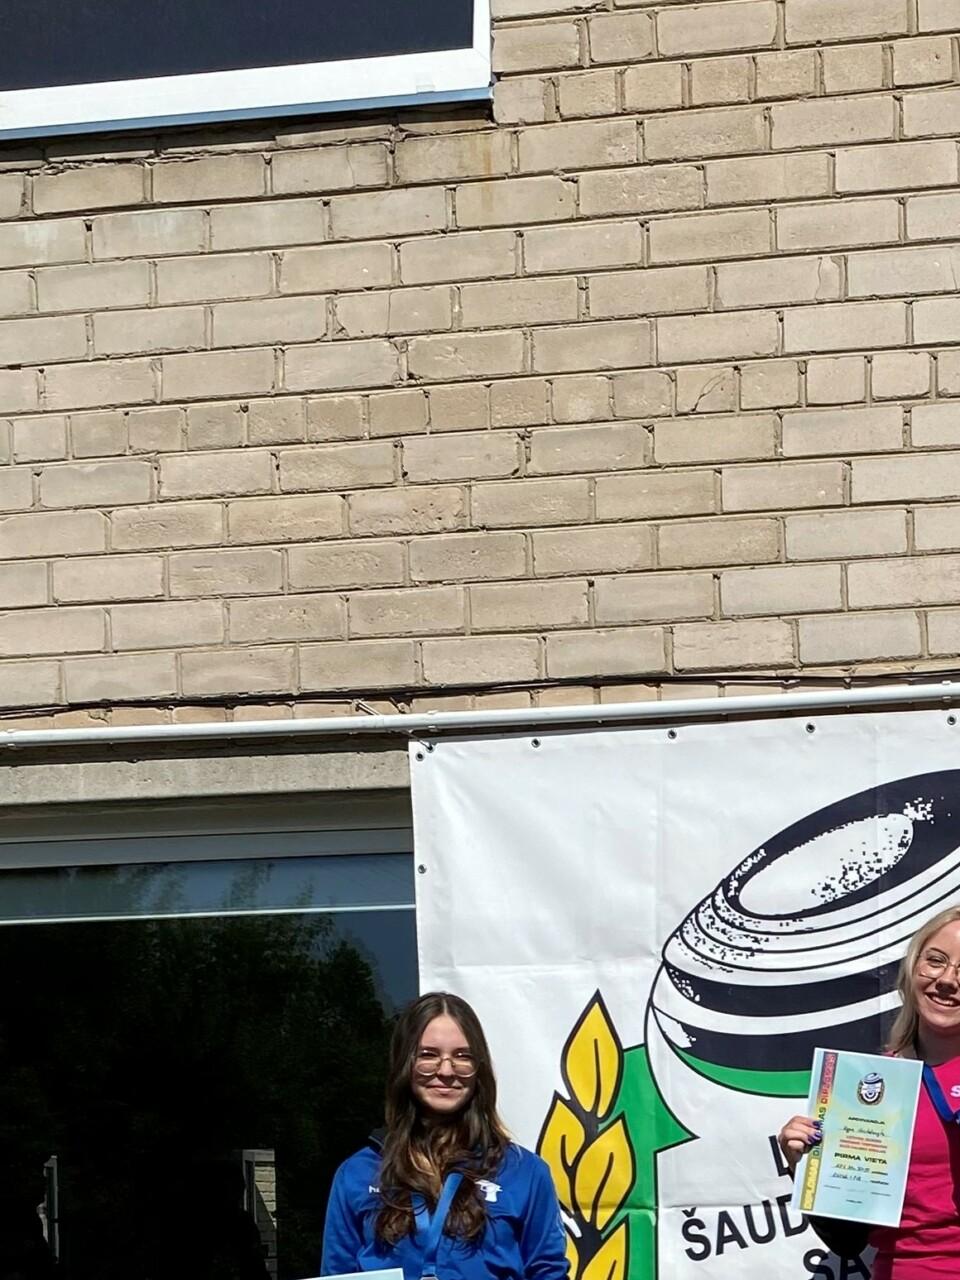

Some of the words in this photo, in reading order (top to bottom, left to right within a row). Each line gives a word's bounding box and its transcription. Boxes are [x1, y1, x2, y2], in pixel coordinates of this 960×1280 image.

[834, 1152, 861, 1161] PIRMA
[864, 1156, 888, 1165] VIETA
[681, 1193, 810, 1261] ŠAUD
